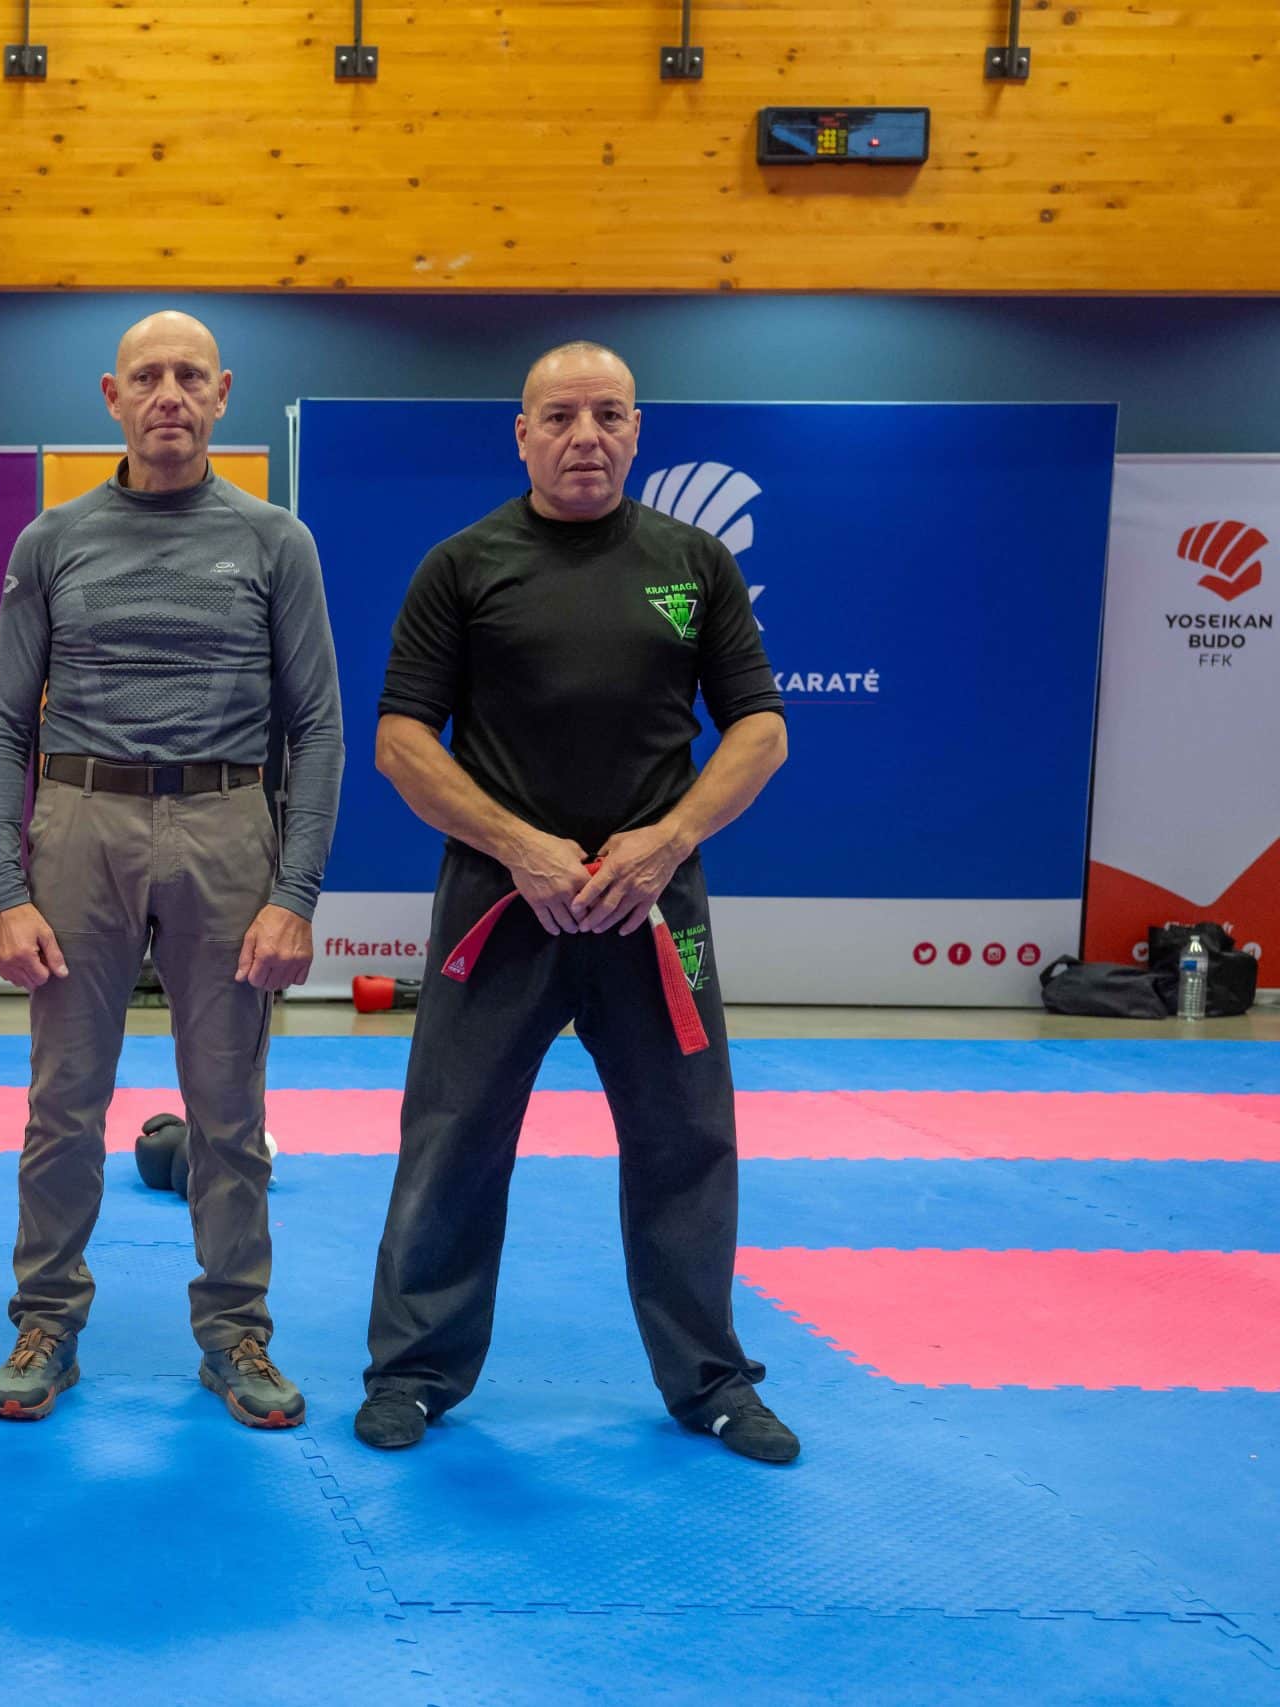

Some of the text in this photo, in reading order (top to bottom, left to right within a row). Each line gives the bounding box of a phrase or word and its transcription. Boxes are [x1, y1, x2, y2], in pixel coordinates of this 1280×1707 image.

[645, 582, 698, 595] KRAV MAGA
[1165, 613, 1272, 629] YOSEIKAN
[1188, 633, 1245, 648] BUDO
[1199, 653, 1232, 667] FFK
